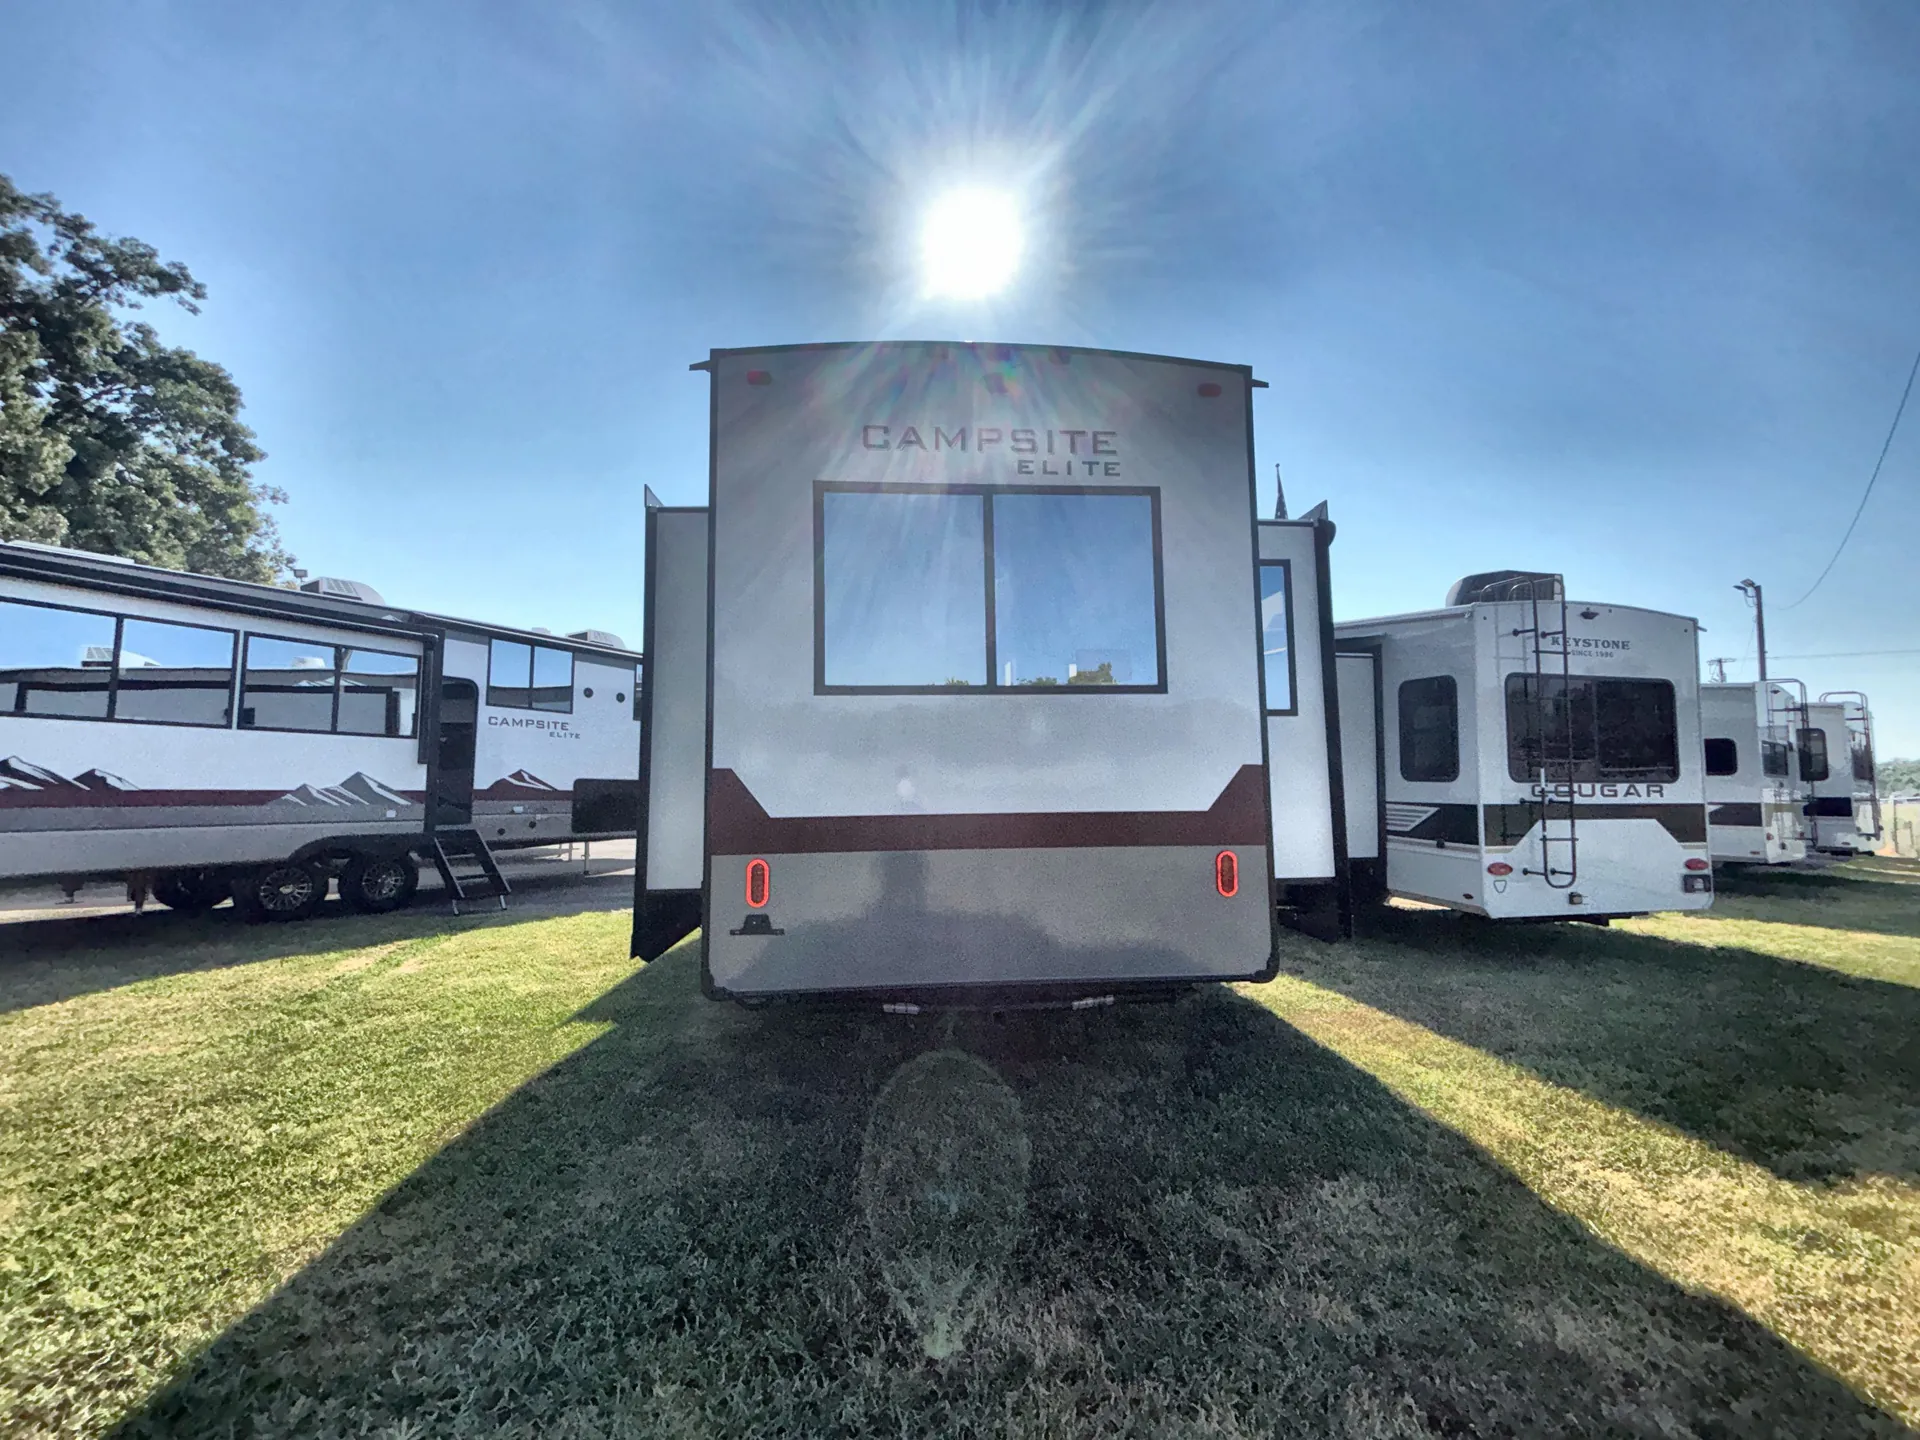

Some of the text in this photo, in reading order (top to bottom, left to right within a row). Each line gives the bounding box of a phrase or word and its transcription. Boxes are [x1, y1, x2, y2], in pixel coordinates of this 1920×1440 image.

[863, 425, 1118, 456] CAMPSITE
[1017, 460, 1121, 477] ELITE
[1550, 636, 1631, 650] KEYSTONE
[488, 716, 569, 731] CAMPSITE
[549, 731, 581, 739] ELITE
[1531, 784, 1664, 798] COUGAR
